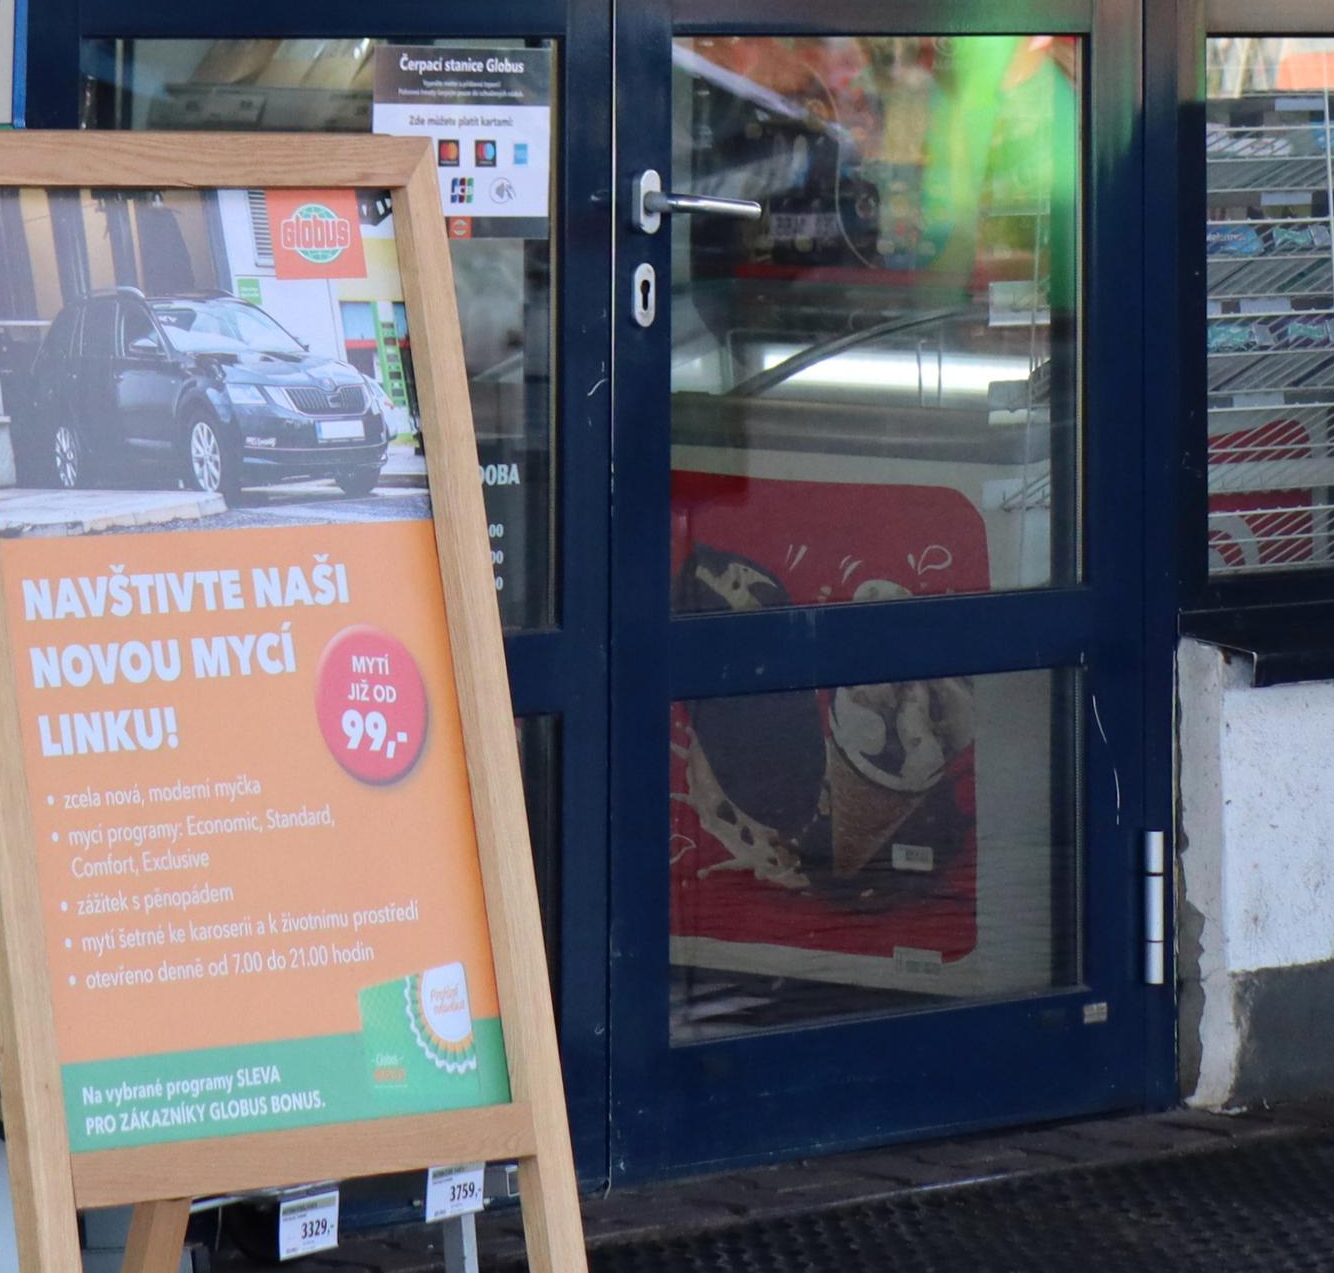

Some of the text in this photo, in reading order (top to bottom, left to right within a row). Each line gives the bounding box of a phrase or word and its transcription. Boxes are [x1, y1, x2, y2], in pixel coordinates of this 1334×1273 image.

[399, 52, 525, 75] Čerpací stanice Globus
[22, 554, 349, 620] NAVŠTIVTE NAŠI
[30, 622, 296, 688] NOVOU MYCÍ
[352, 654, 389, 675] MYTÍ
[348, 679, 397, 703] JIŽ OD
[38, 707, 179, 756] LINKU!
[63, 774, 261, 809] zcela nová, moderní myčka
[68, 804, 335, 850] mycí programy: Economic, Standard,
[71, 848, 209, 878] Comfort, Exclusive
[77, 884, 234, 916] zážitek s pěnopádem
[81, 900, 419, 957] mytí šetrné ke karoserii a k životnímu prostředí
[86, 942, 374, 989] otevřeno denně od 7.00 do 21.00 hodin
[82, 1065, 281, 1105] Na vybrané programy SLEVA
[85, 1090, 326, 1135] PRO ZÁKAZNÍKY GLOBUS BONUS.
